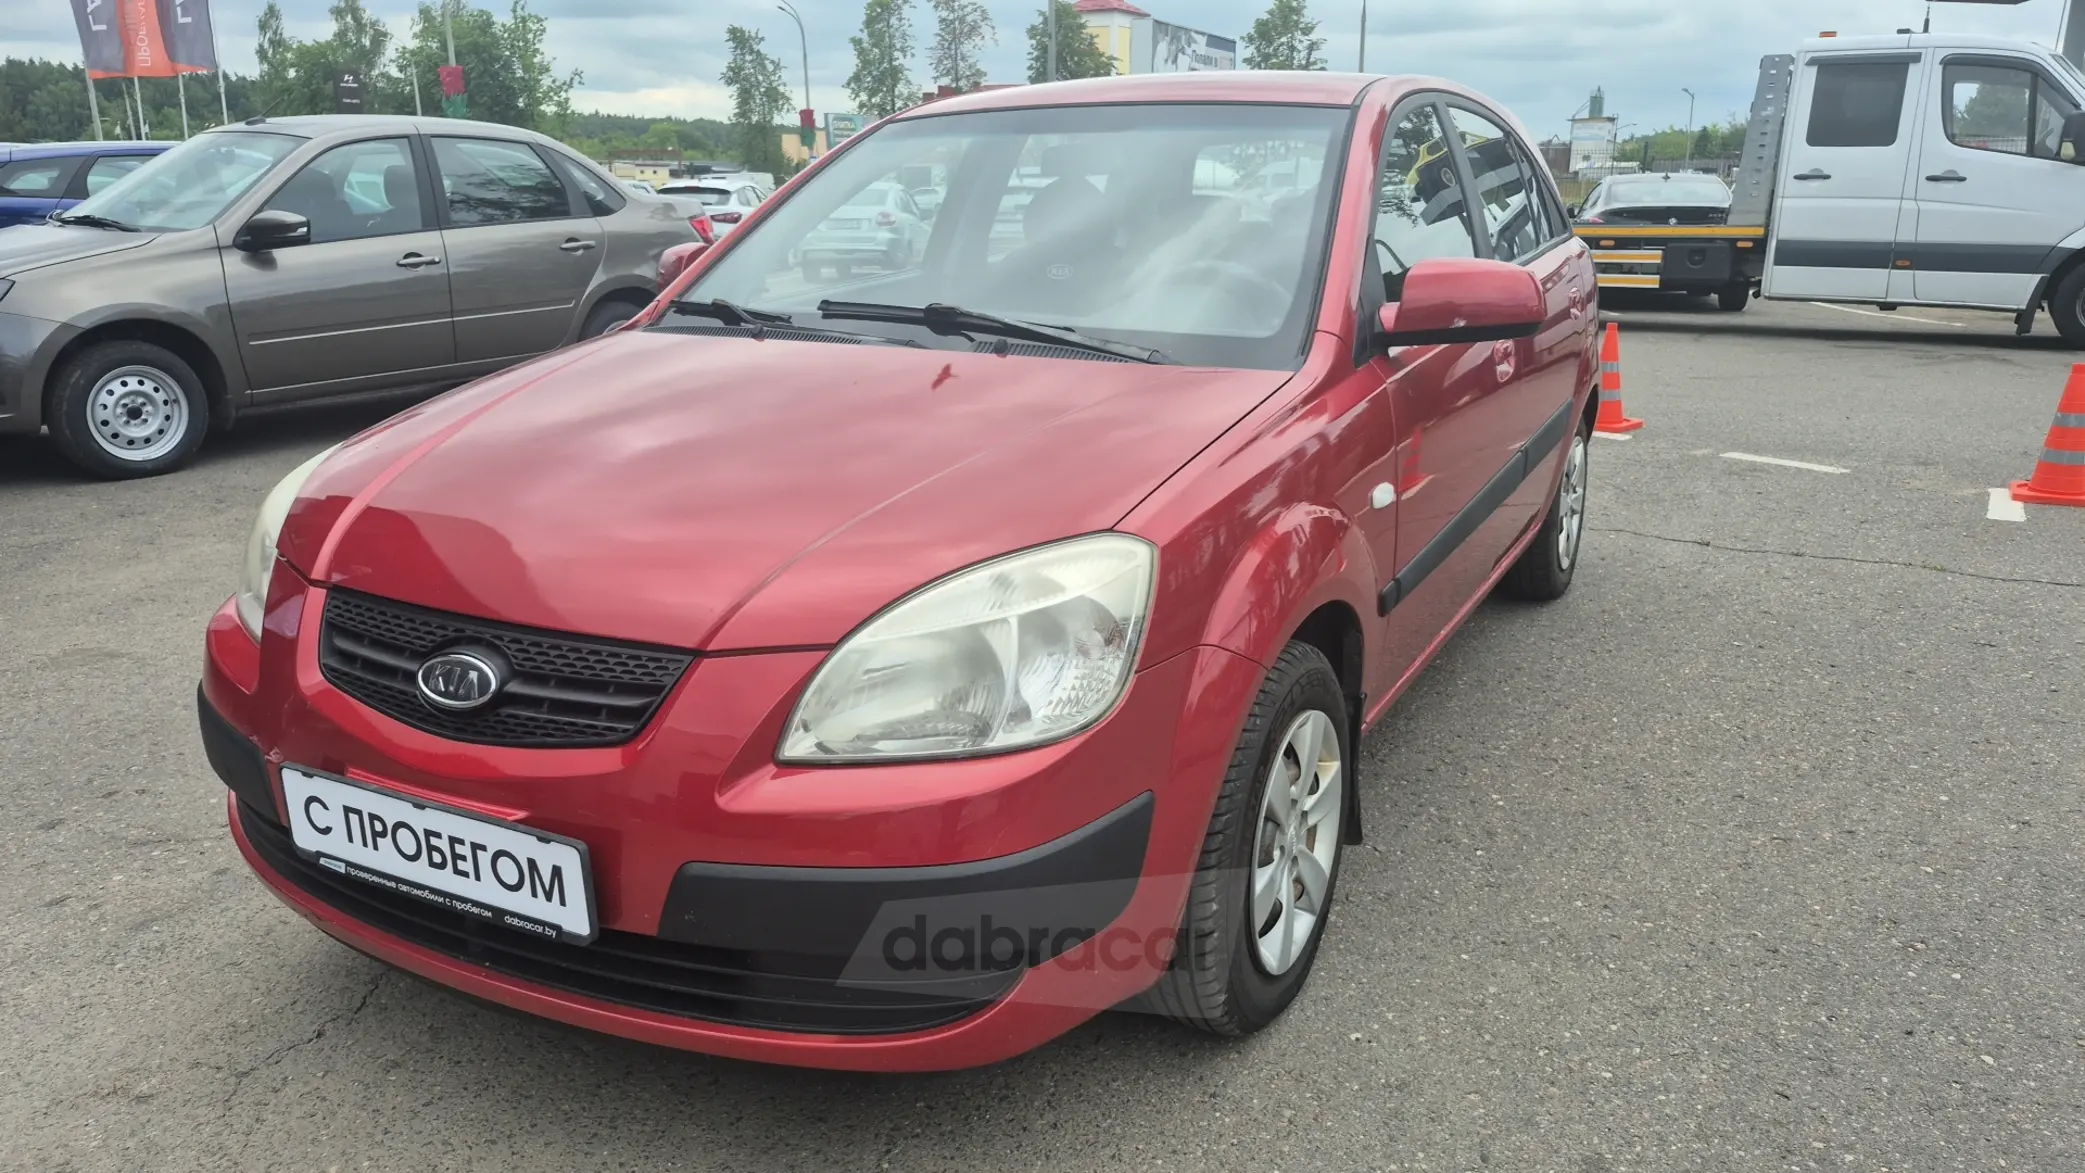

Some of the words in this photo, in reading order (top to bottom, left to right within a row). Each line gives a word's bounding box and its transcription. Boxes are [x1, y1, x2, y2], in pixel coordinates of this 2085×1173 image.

[428, 663, 479, 700] KIA
[304, 795, 333, 836] С
[342, 804, 567, 908] ПРОБЕГОМ
[346, 866, 396, 888] проверенные
[397, 883, 444, 903] автомобили
[452, 899, 493, 919] пробегом
[504, 914, 557, 939] dabracar.by
